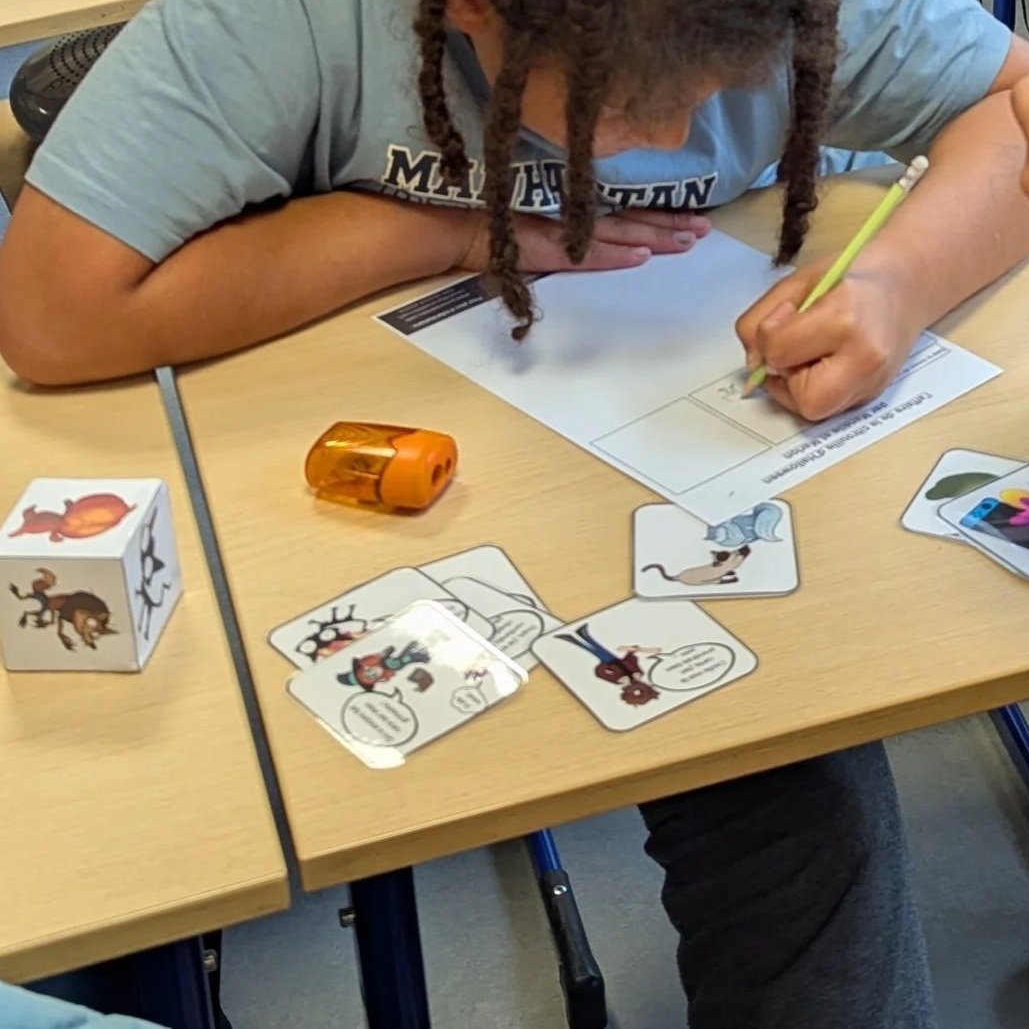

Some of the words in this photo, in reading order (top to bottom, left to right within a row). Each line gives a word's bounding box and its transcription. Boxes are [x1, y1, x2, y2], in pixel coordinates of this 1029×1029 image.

[383, 143, 718, 211] MAHATAN
[783, 437, 823, 459] Marion
[827, 425, 871, 450] citrouille
[762, 449, 826, 484] d'Halloween
